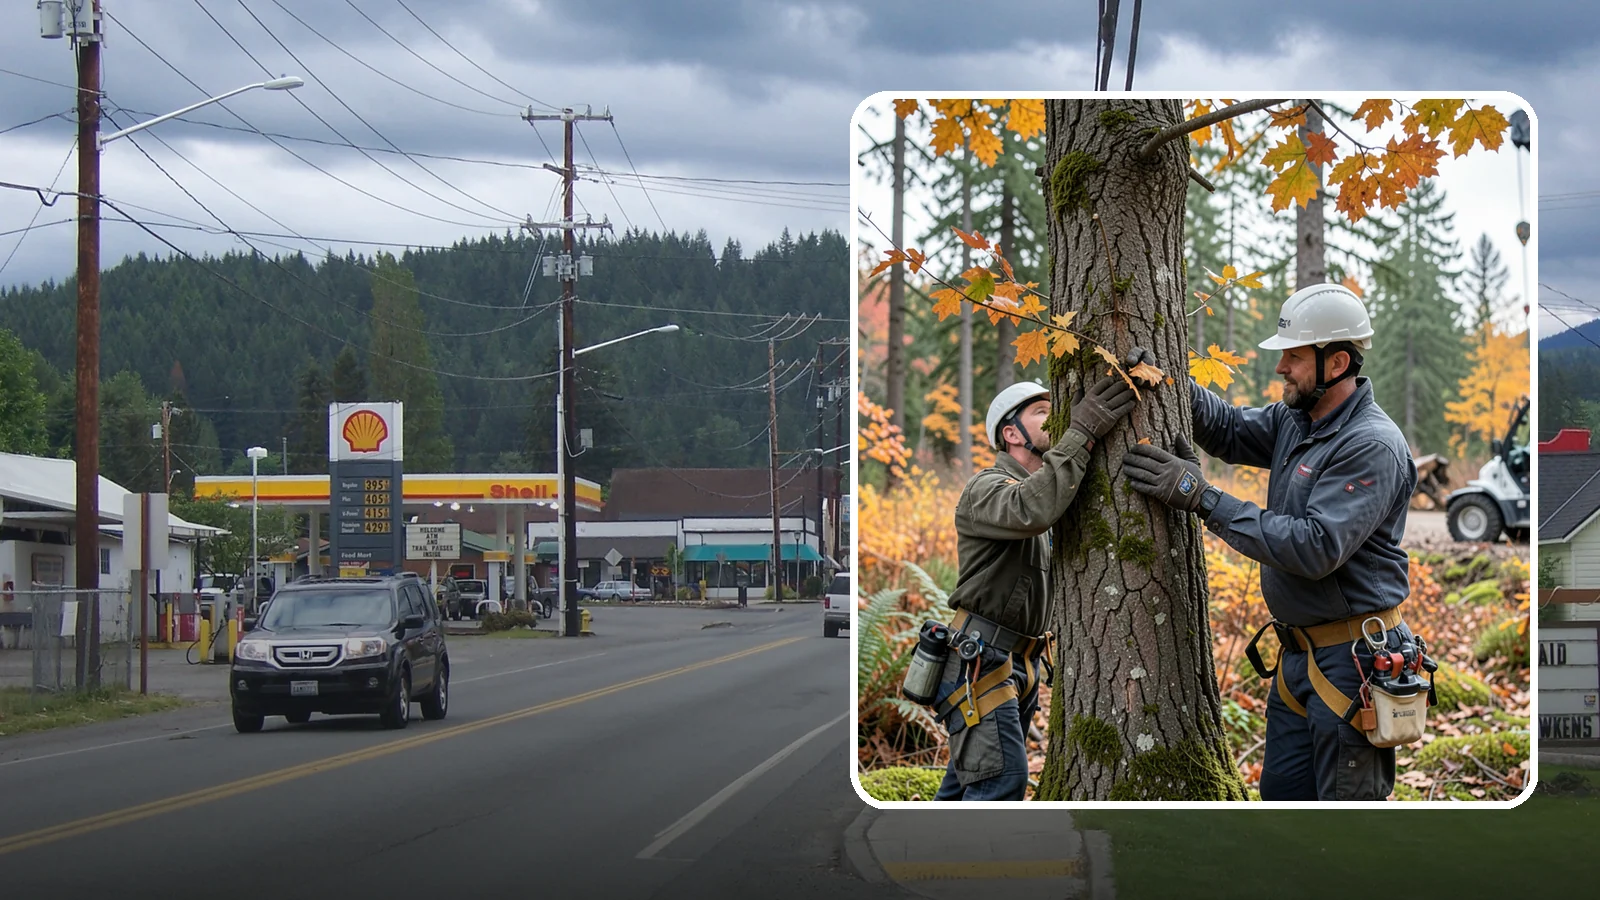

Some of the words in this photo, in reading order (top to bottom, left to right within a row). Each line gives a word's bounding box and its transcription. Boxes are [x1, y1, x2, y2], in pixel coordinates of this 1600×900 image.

[365, 480, 384, 490] 395
[490, 484, 547, 499] Shell
[365, 494, 384, 504] 405
[365, 508, 383, 518] 415
[365, 522, 384, 532] 429
